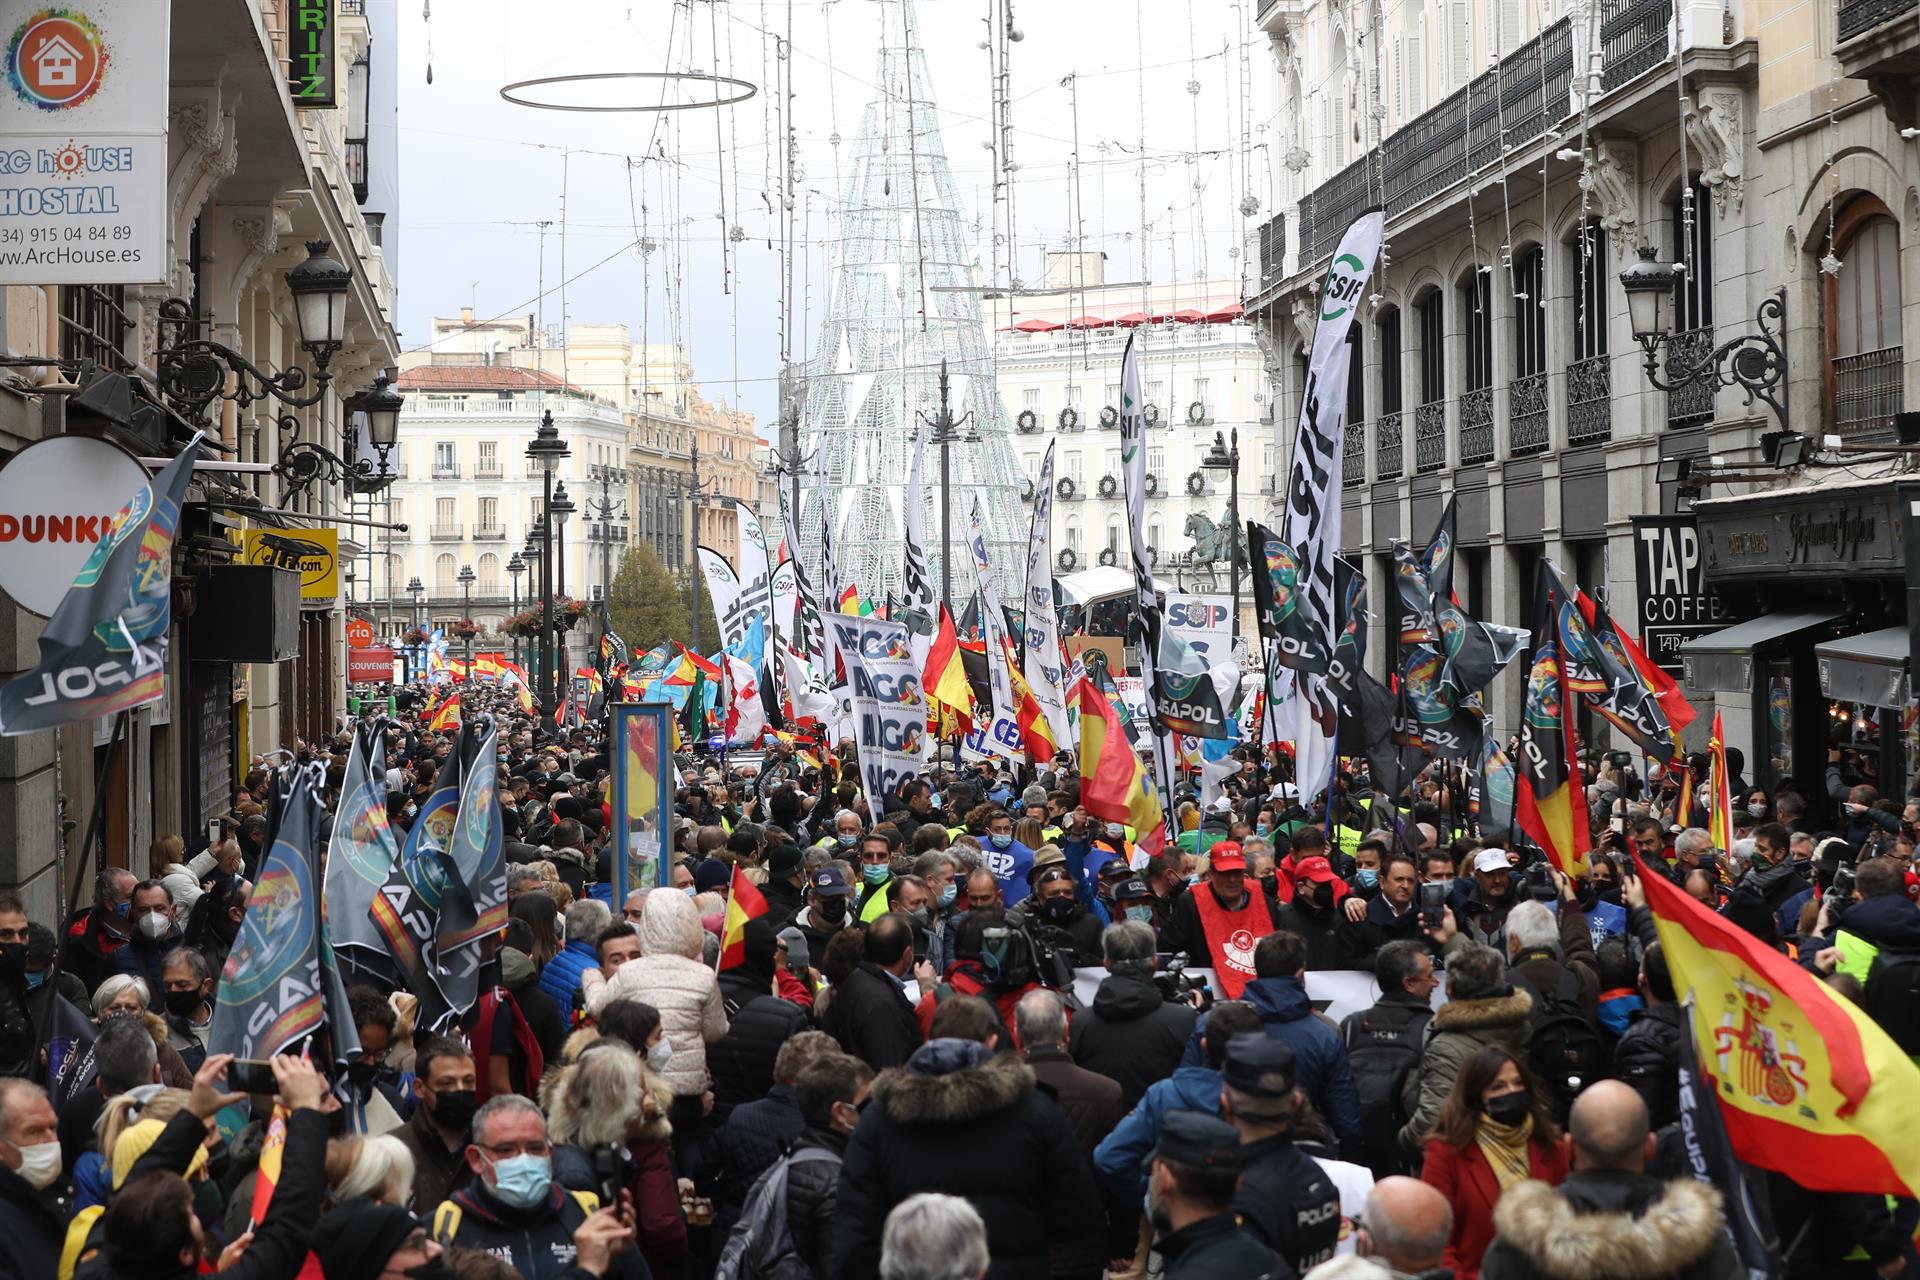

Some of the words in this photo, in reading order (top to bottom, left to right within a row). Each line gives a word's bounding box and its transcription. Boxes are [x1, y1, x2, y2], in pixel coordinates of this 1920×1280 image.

[0, 186, 119, 216] HOSTAL
[30, 227, 58, 242] 915
[63, 226, 82, 241] 04
[88, 226, 107, 241] 84
[113, 225, 131, 240] 89
[1323, 271, 1364, 303] CSIF
[775, 580, 794, 591] CSIF
[1645, 597, 1736, 621] COFFE
[350, 624, 370, 638] ria
[351, 661, 394, 671] SOUVENIRS
[852, 666, 922, 706] AGC
